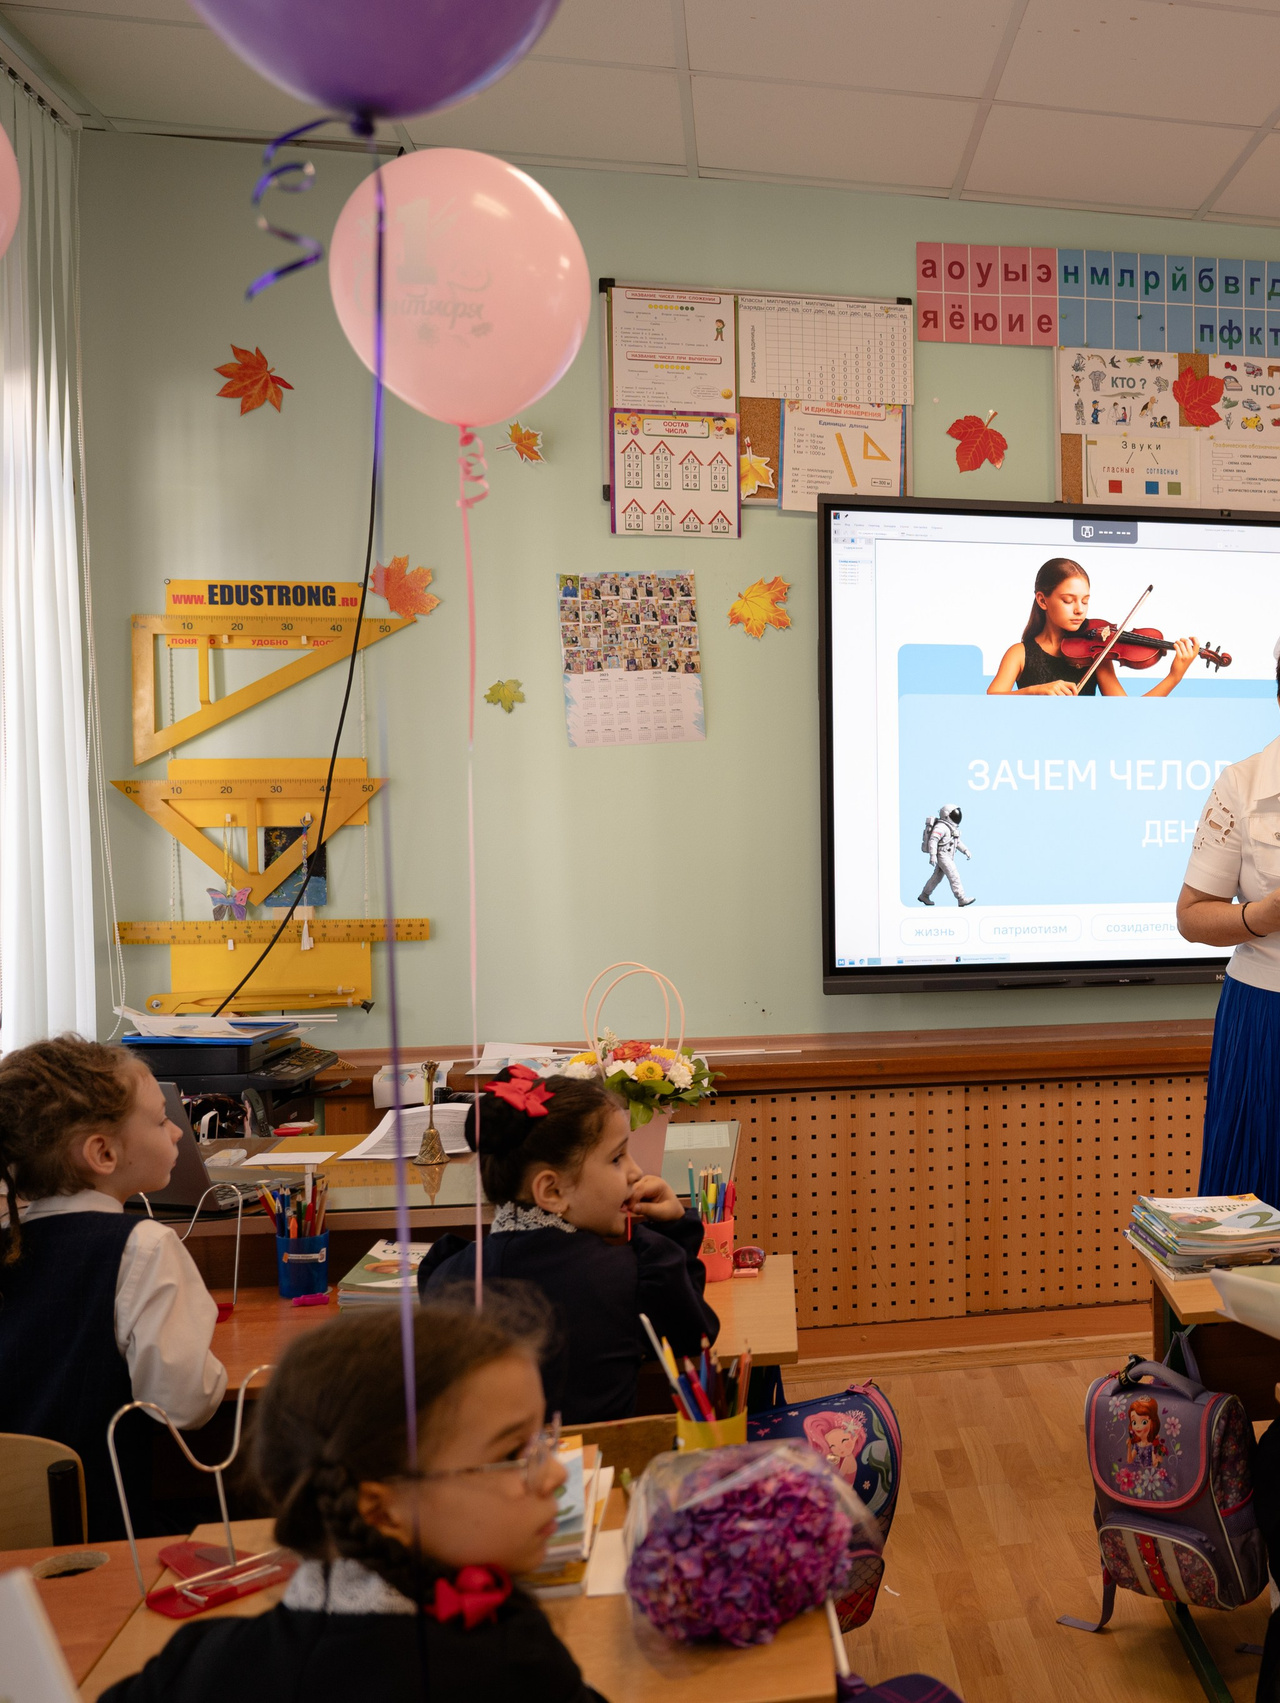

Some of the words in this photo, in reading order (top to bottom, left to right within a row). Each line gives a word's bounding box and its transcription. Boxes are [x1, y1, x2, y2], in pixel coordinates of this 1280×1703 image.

[922, 258, 937, 278] а
[948, 261, 964, 280] о
[976, 263, 992, 288] у
[1004, 264, 1027, 282] ы
[1036, 264, 1052, 282] э
[1064, 266, 1079, 284] н
[1090, 267, 1110, 285] м
[1118, 268, 1134, 287] л
[1144, 270, 1160, 295] р
[1172, 266, 1187, 291] й
[1198, 268, 1214, 292] б
[1224, 276, 1240, 294] в
[1250, 278, 1260, 294] г
[767, 298, 800, 306] миллиарды
[922, 310, 938, 328] я
[950, 304, 964, 330] ё
[974, 312, 998, 331] ю
[1008, 314, 1024, 332] и
[1037, 314, 1052, 333] е
[1200, 324, 1214, 342] п
[1219, 320, 1242, 349] ф
[1250, 326, 1262, 345] к
[1111, 376, 1136, 389] КТО
[1140, 378, 1147, 390] ?
[1251, 384, 1274, 396] ЧТО
[811, 407, 842, 415] ЕДИНИЦЫ
[844, 410, 881, 418] ИЗМЕРЕНИЯ
[819, 420, 846, 428] Единицы
[1102, 465, 1135, 474] гласные
[1146, 467, 1179, 476] согласные
[181, 622, 193, 631] 10
[231, 622, 244, 631] 20
[281, 622, 293, 631] 30
[330, 624, 342, 633] 40
[379, 624, 391, 633] 50
[251, 639, 289, 647] УДОБНО
[968, 760, 1097, 791] ЗАЧЕМ
[171, 786, 182, 795] 10
[220, 786, 233, 794] 20
[270, 785, 282, 794] 30
[362, 784, 374, 793] 50
[914, 926, 955, 938] жизнь
[993, 924, 1068, 937] патриотизм
[1106, 922, 1176, 934] созидатель
